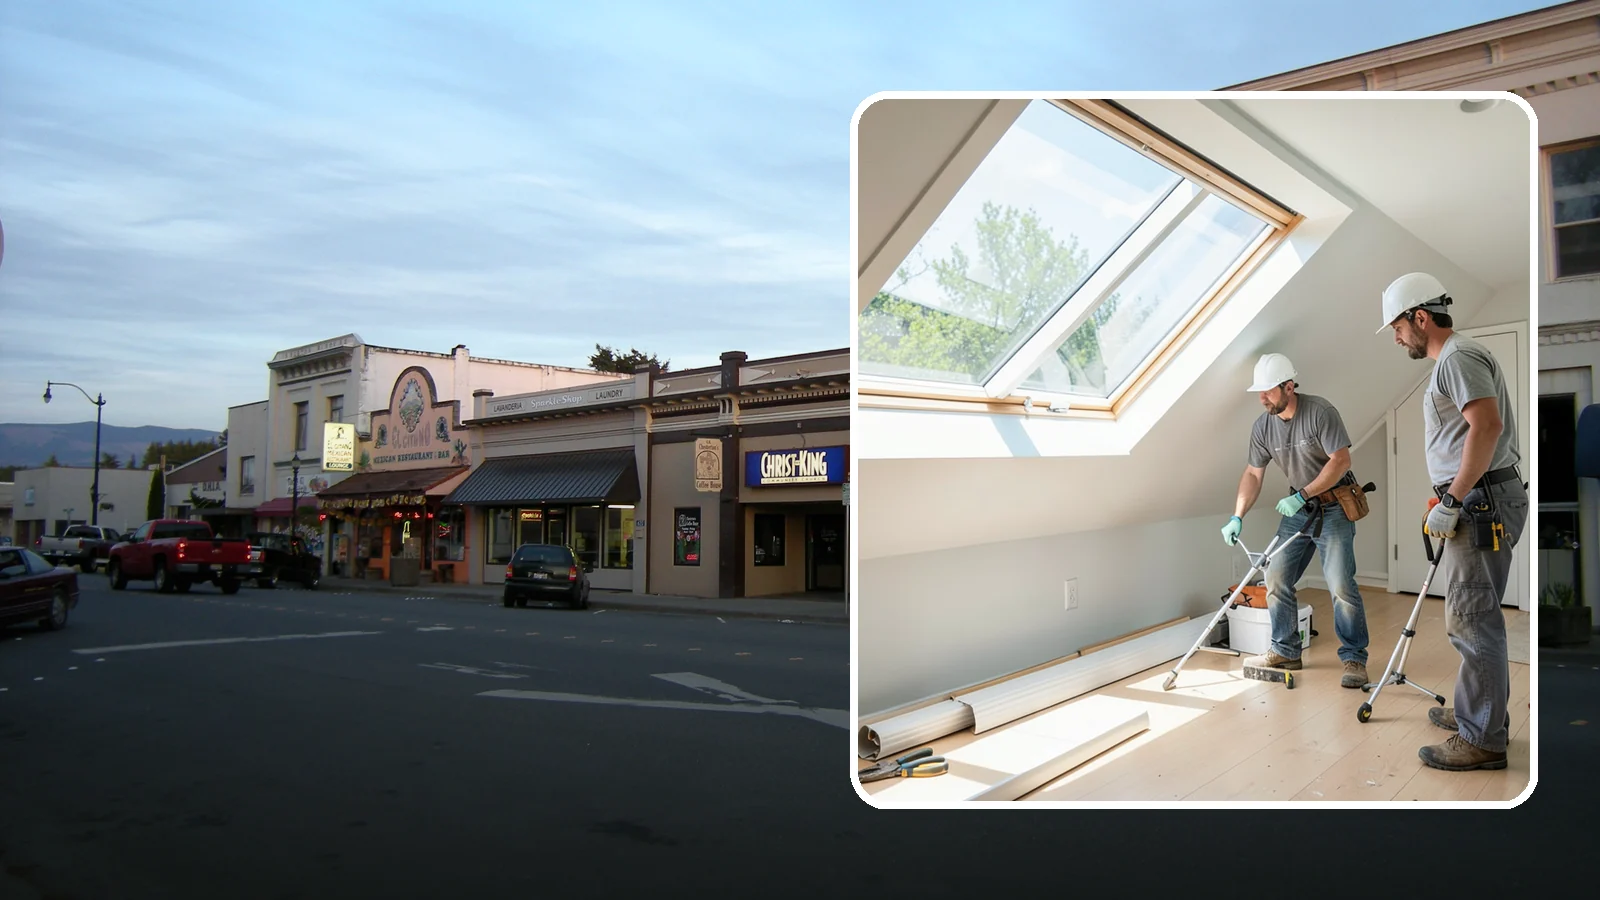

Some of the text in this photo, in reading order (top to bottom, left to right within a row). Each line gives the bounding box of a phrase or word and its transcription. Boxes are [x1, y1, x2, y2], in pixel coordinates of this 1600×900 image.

[561, 394, 583, 404] Shop
[595, 388, 623, 400] LAUNDRY
[493, 402, 522, 412] LAVANDERIA
[373, 454, 396, 463] MEXICAN
[398, 451, 433, 462] RESTAURANT
[438, 450, 450, 459] BAR
[761, 450, 827, 478] CHRIST KING
